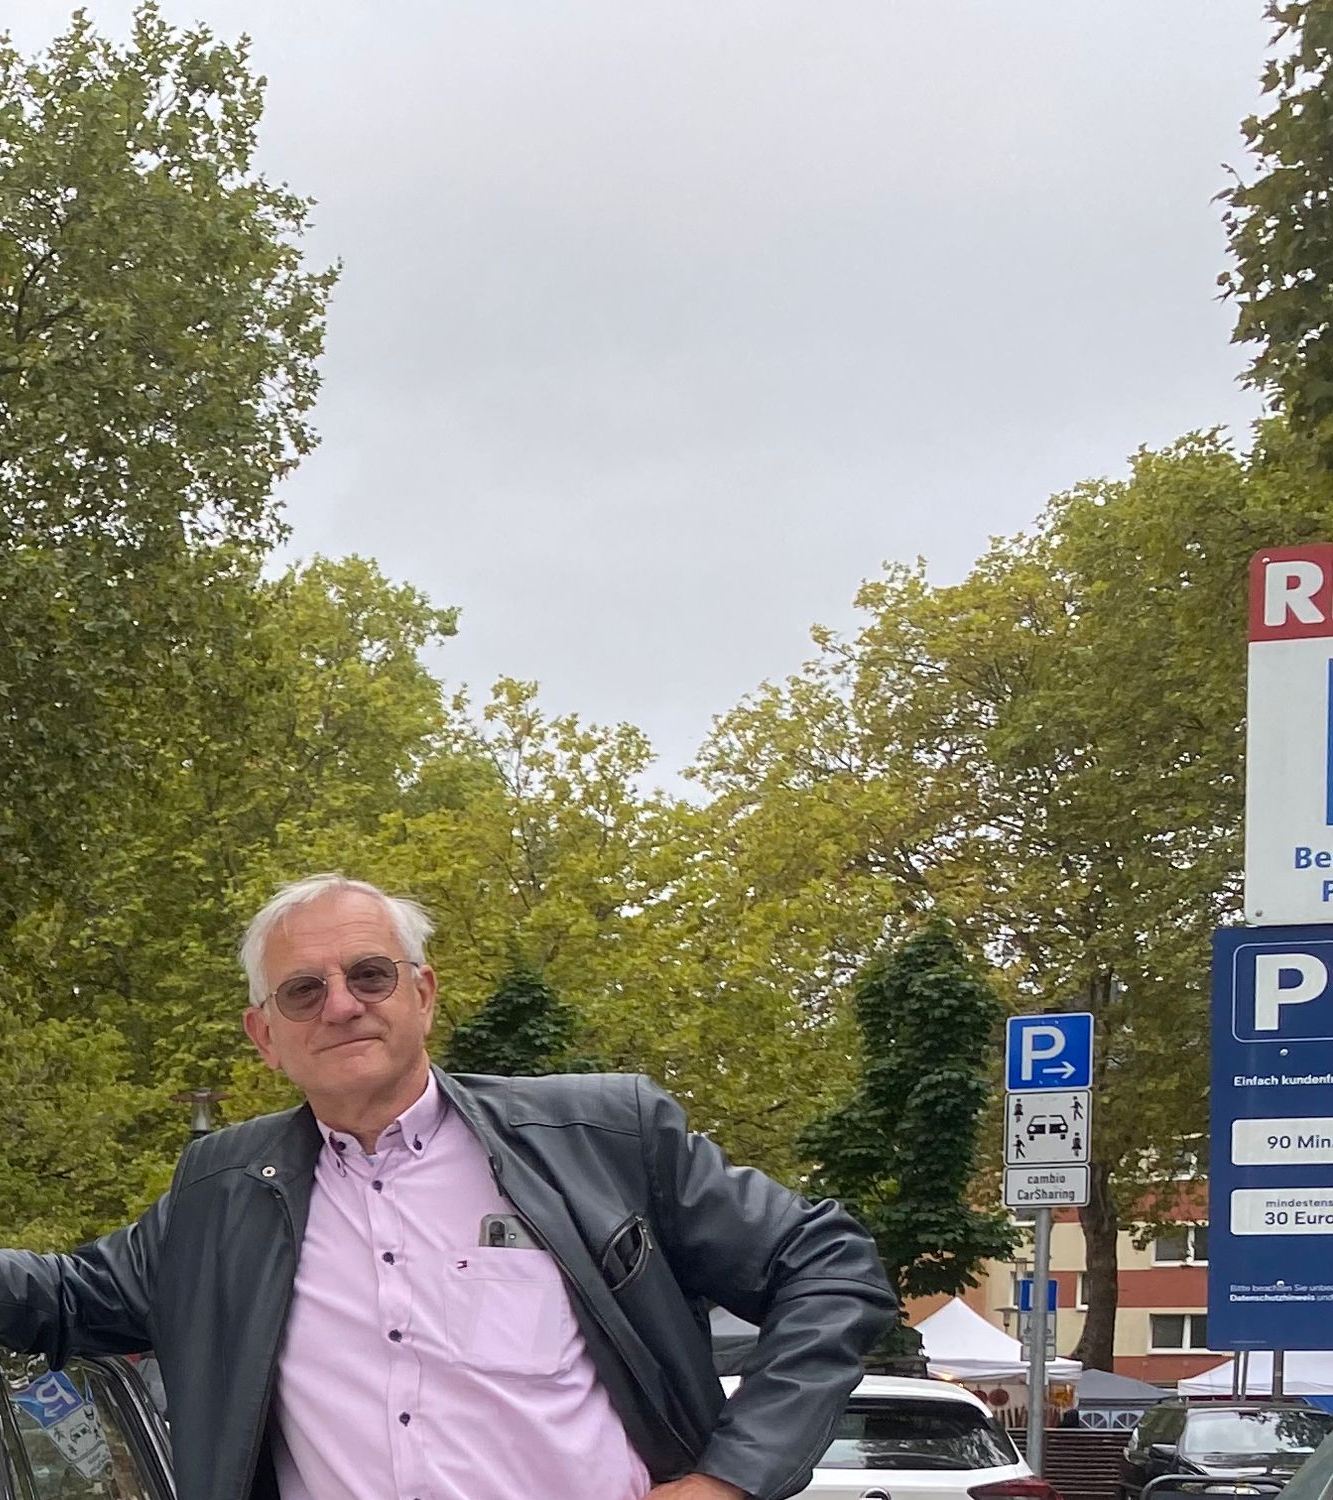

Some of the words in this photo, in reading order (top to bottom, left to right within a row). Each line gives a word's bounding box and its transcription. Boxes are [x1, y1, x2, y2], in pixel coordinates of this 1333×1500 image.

[1264, 561, 1333, 626] R
[1255, 953, 1328, 1031] P
[1021, 1026, 1066, 1081] P
[1234, 1076, 1279, 1086] Einfach
[1267, 1135, 1291, 1149] 90
[1027, 1172, 1066, 1184] cambio
[1017, 1187, 1075, 1202] CarSharing
[1265, 1212, 1288, 1225] 30
[1252, 1284, 1292, 1292] beachn
